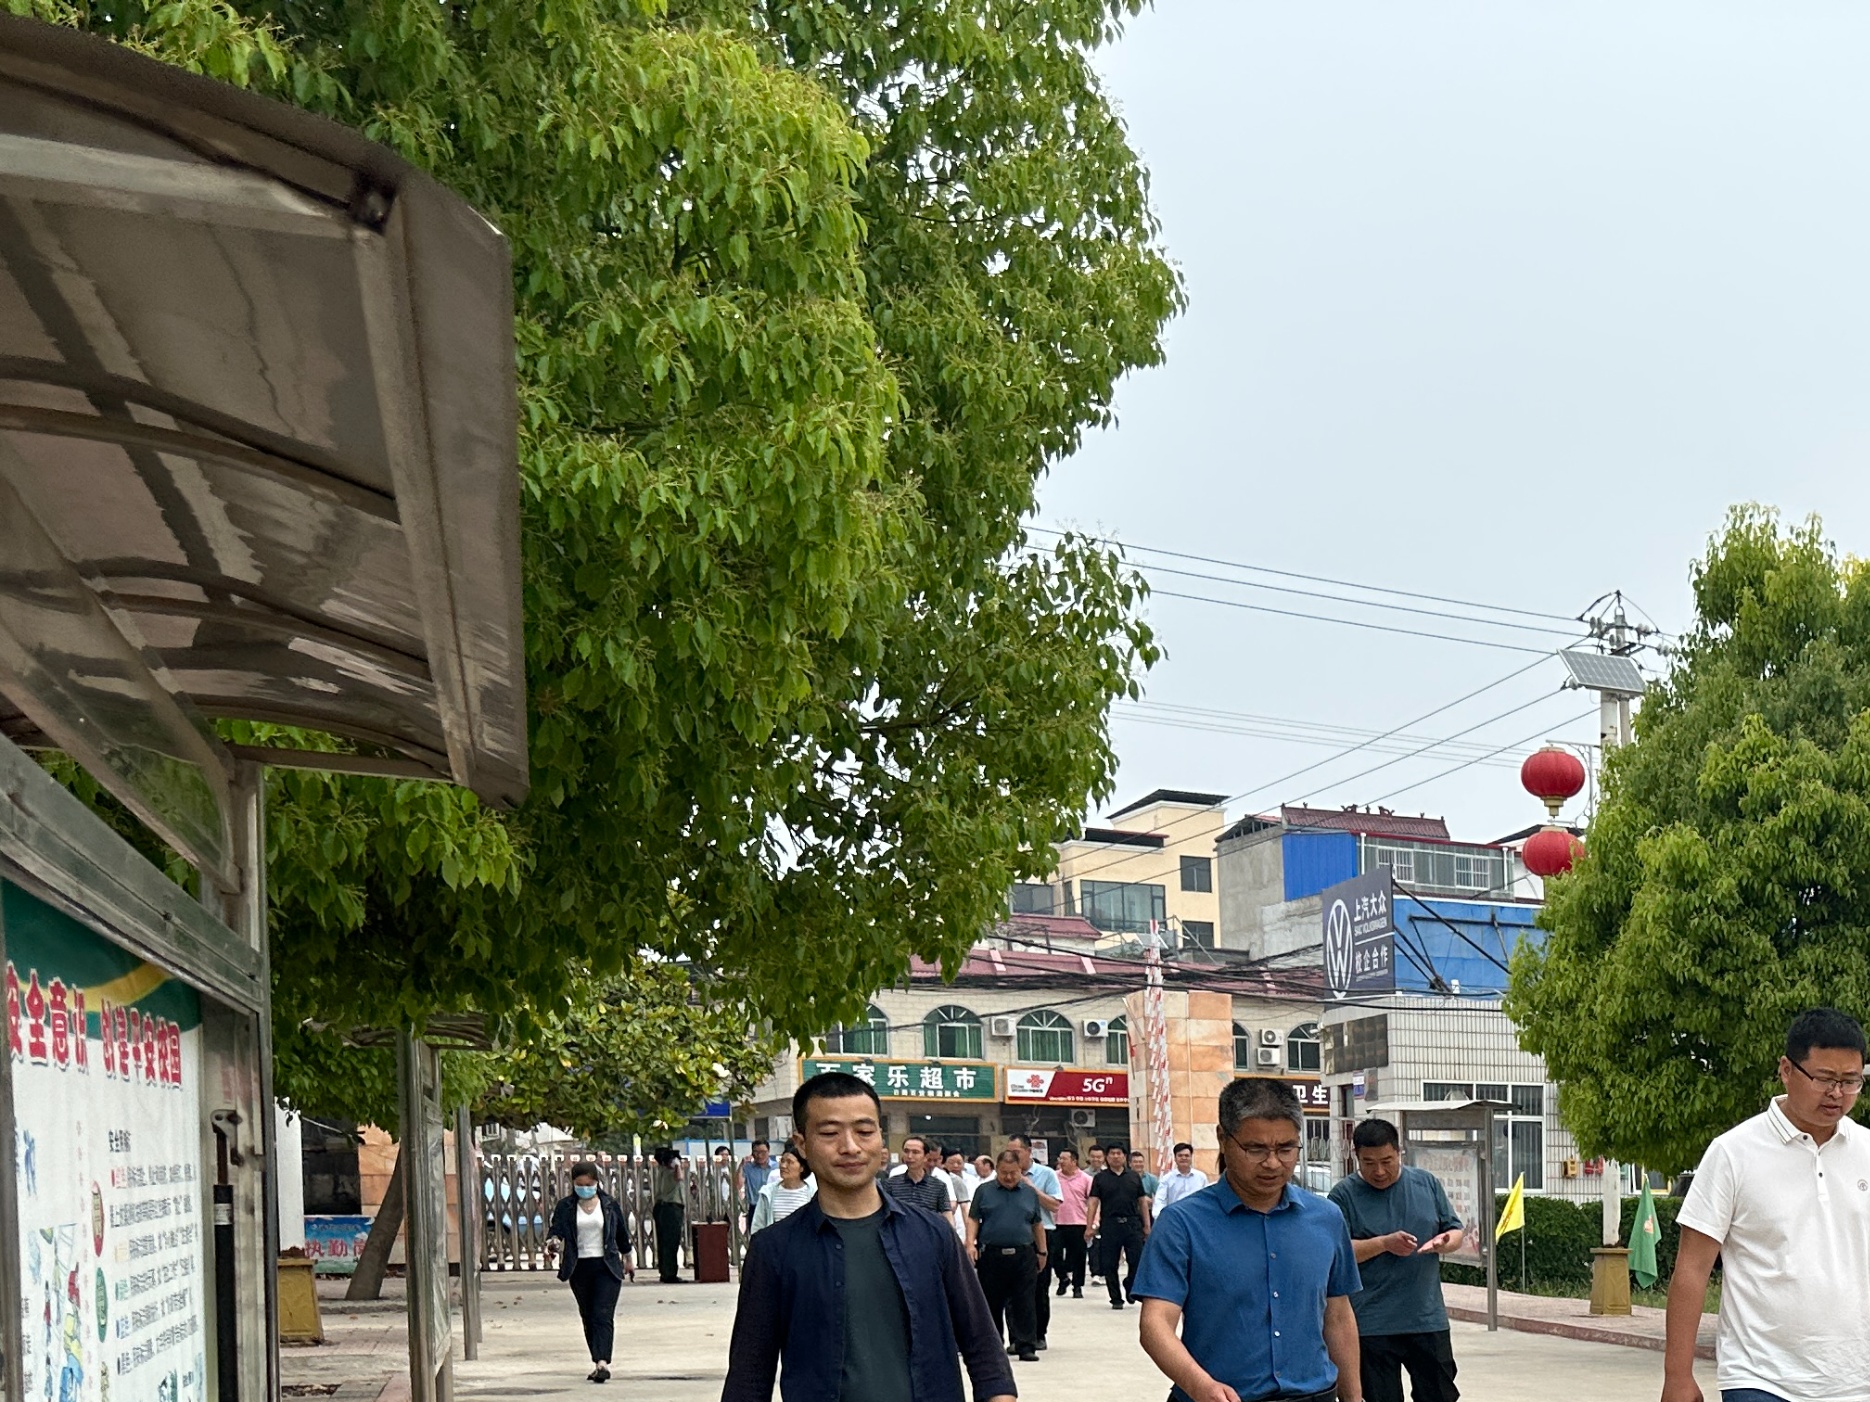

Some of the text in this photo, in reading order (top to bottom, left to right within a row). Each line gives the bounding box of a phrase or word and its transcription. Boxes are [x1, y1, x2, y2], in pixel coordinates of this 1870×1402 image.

[1354, 890, 1387, 921] 上汽大众
[1292, 1085, 1329, 1105] 卫生
